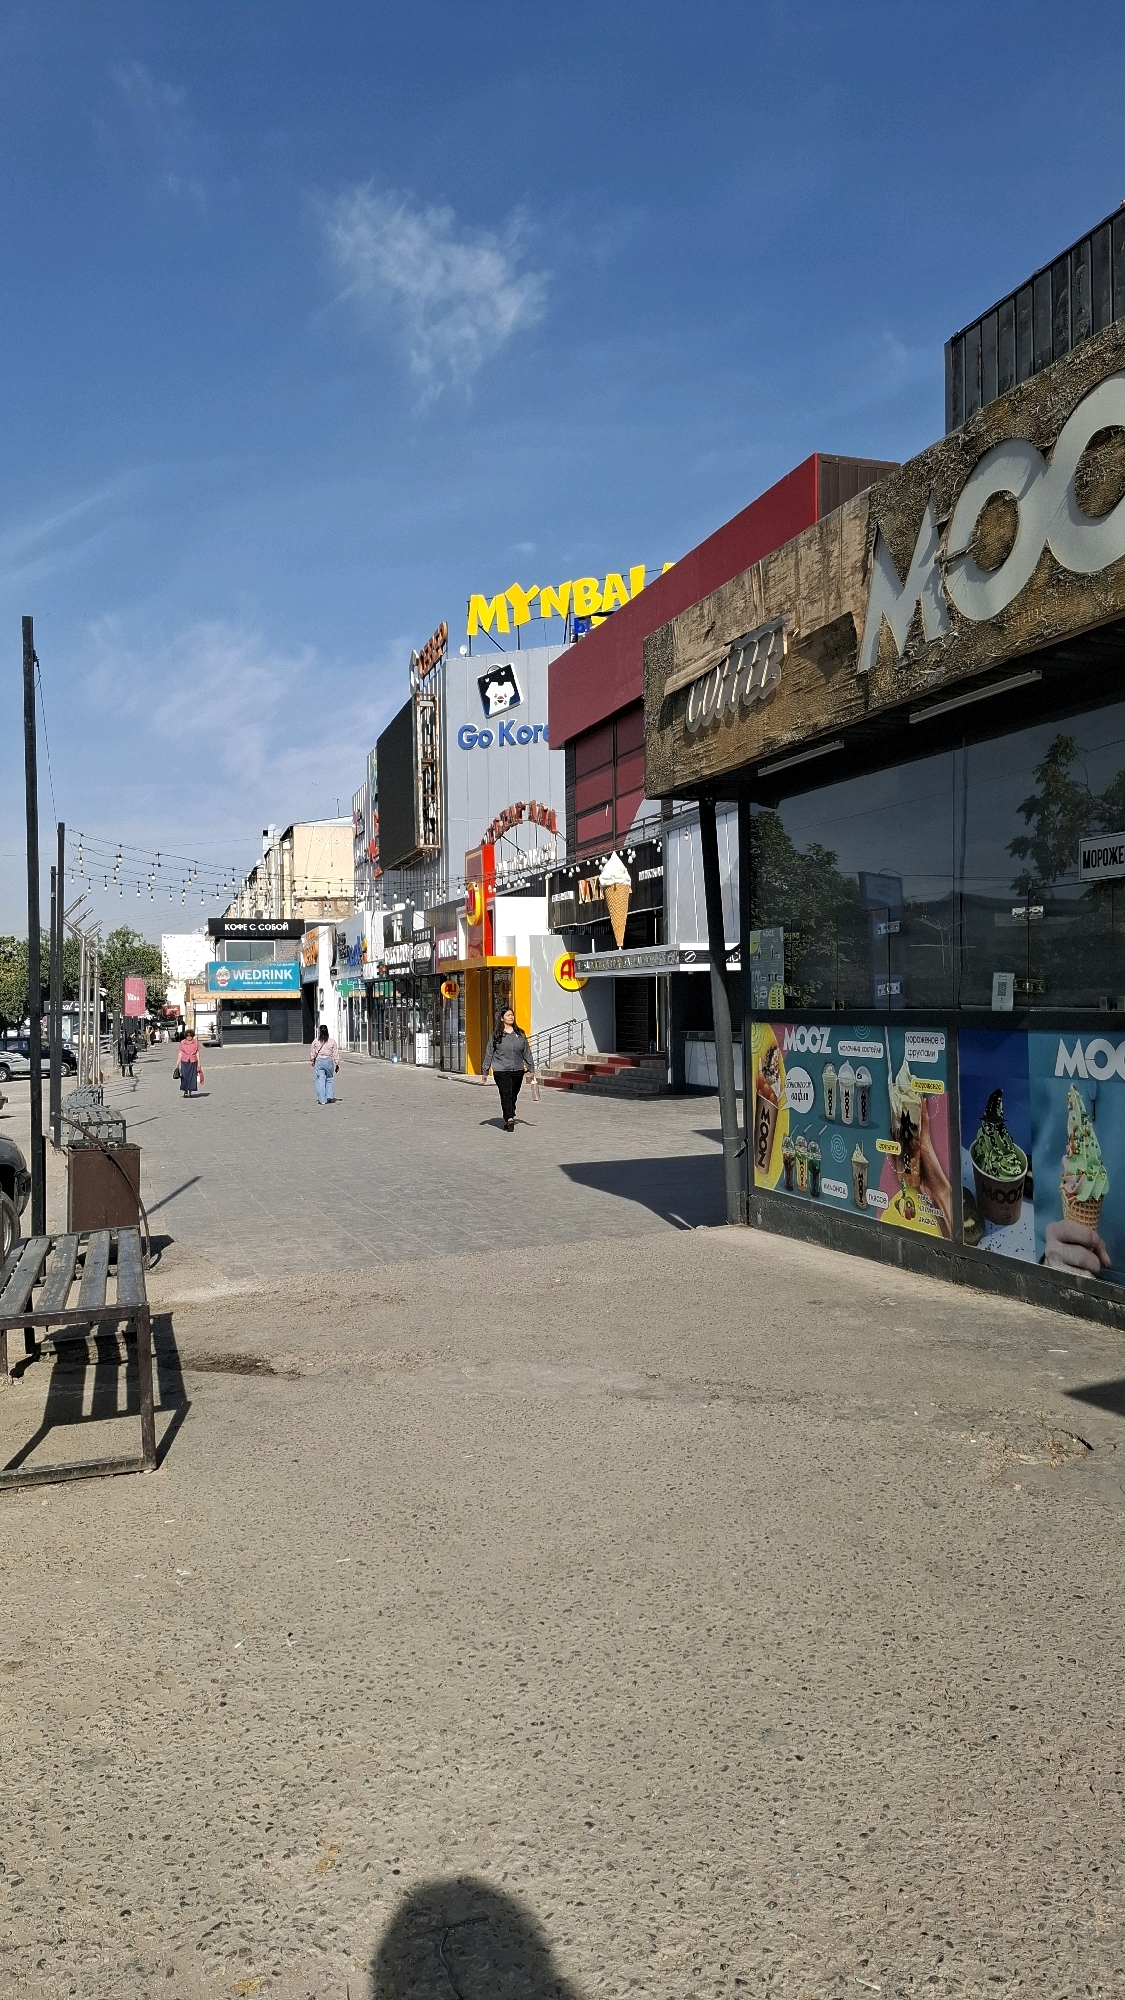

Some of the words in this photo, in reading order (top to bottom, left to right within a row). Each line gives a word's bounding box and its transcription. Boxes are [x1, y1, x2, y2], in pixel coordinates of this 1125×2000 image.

[458, 723, 495, 750] Go
[1082, 845, 1125, 869] МОРОЖЕ
[224, 923, 248, 931] КОФЕ
[249, 923, 256, 931] С
[258, 921, 289, 931] СОБОЙ
[232, 968, 294, 980] WEDRINK
[783, 1026, 832, 1053] MOOZ
[757, 1104, 771, 1169] MOOZ
